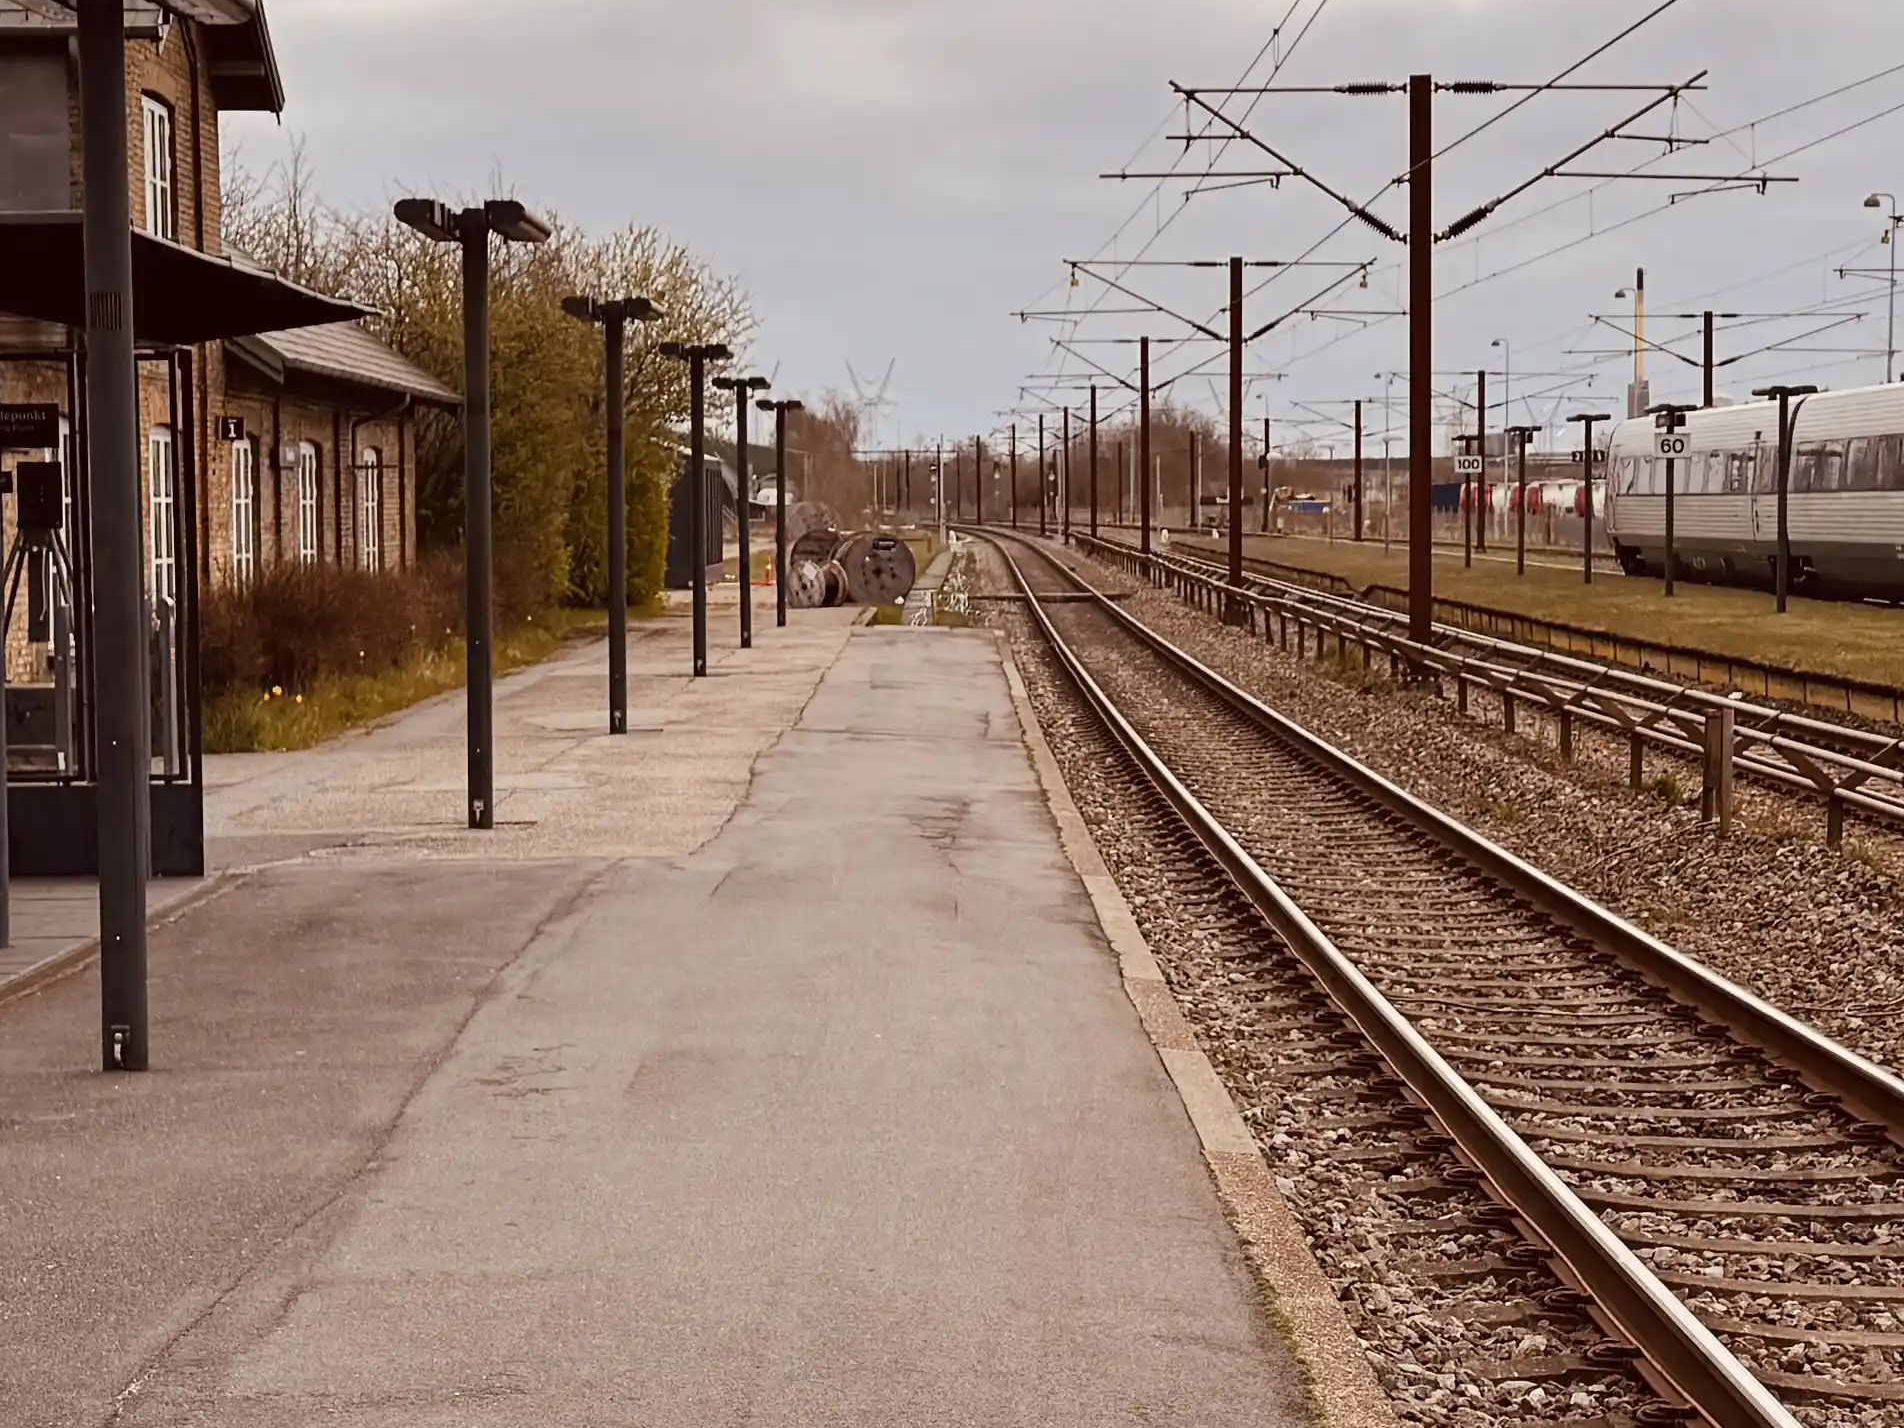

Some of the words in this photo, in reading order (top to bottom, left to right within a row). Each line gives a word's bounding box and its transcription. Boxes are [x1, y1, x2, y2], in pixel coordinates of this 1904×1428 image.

[228, 423, 237, 438] 1
[1660, 438, 1685, 454] 60
[1457, 458, 1480, 470] 100
